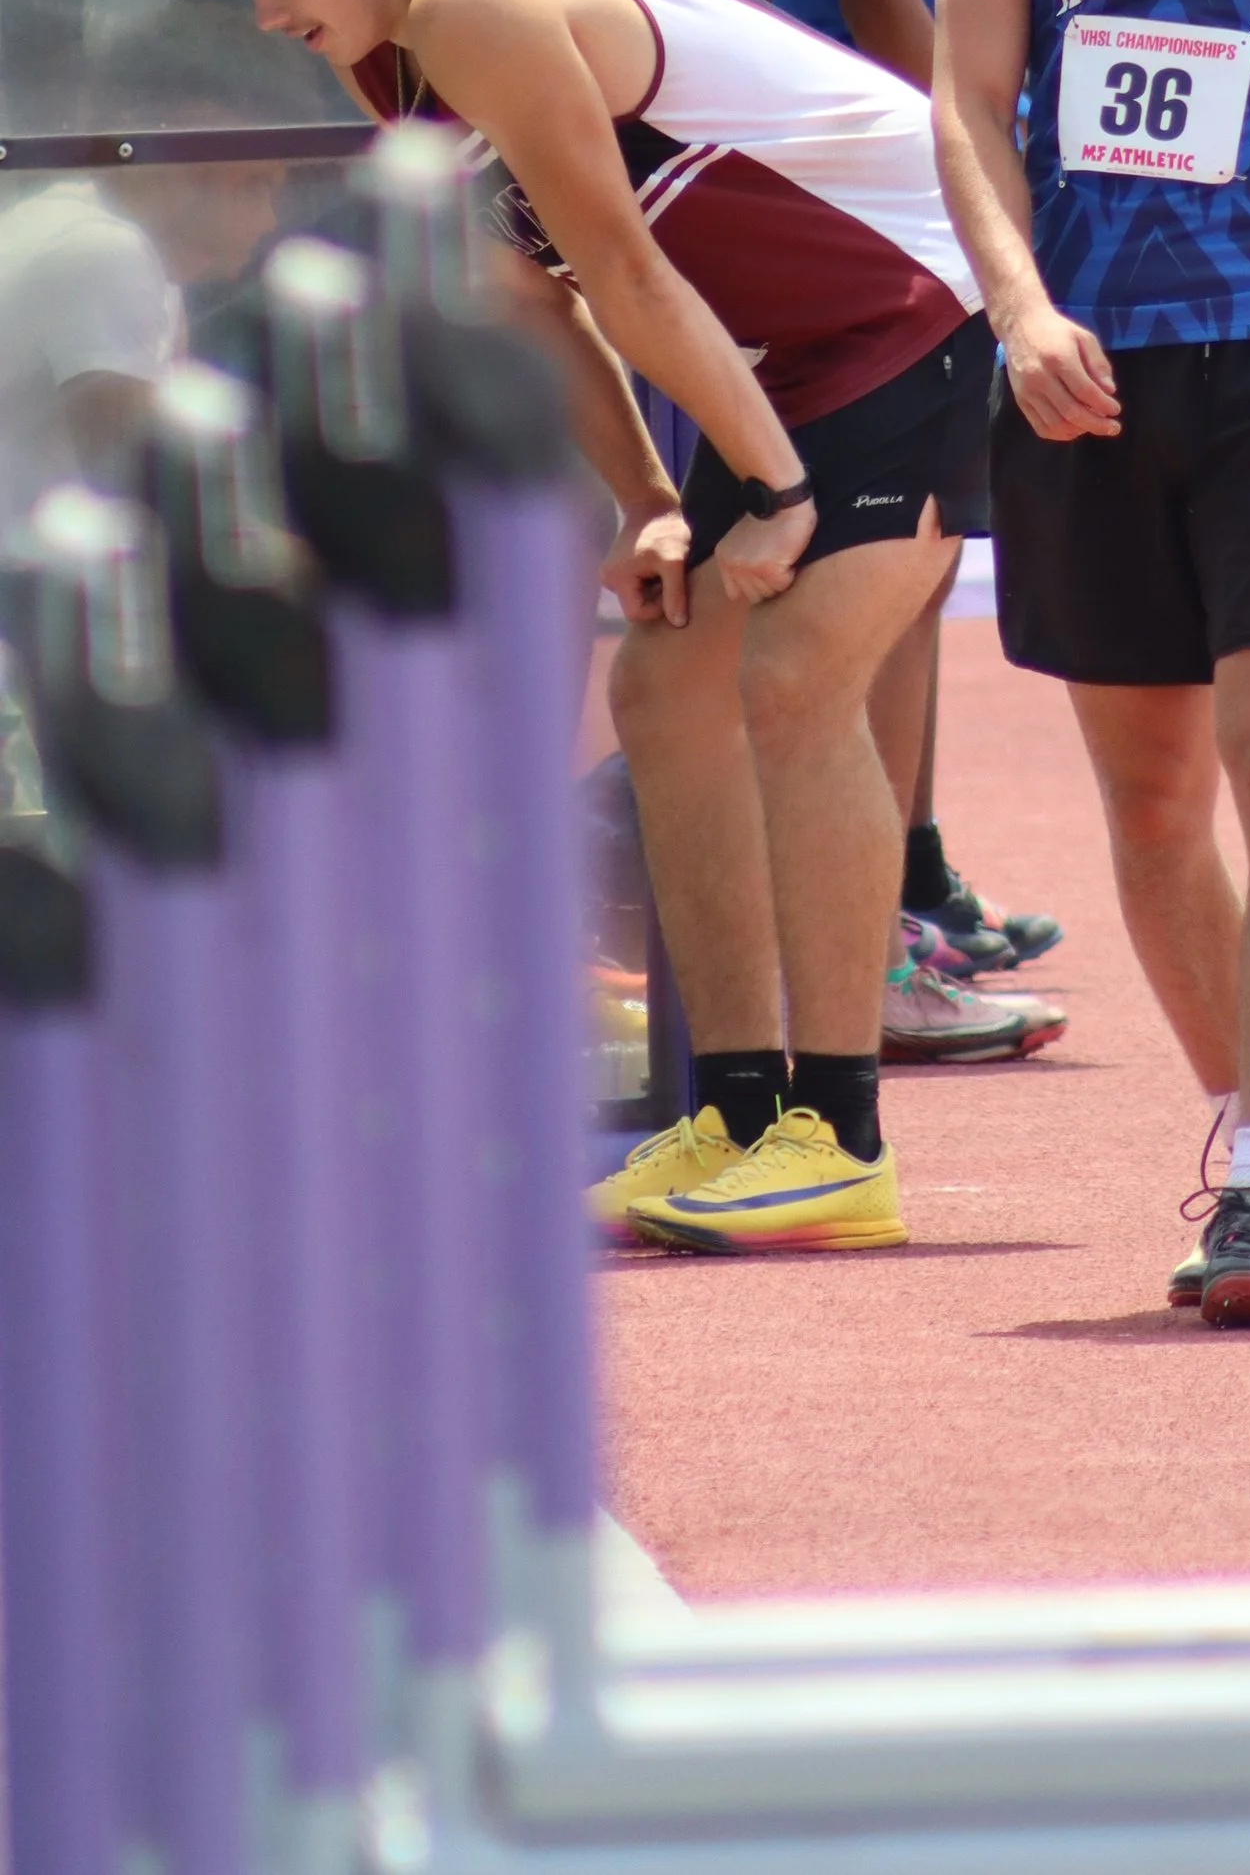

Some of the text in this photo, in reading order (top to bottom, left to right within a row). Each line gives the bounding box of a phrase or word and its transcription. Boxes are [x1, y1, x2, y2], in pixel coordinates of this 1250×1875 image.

[1080, 29, 1238, 61] VHSL CHAMPIONSHIPS
[1099, 61, 1193, 142] 36
[1081, 144, 1107, 162] MF
[1108, 147, 1196, 172] ATHLETIC
